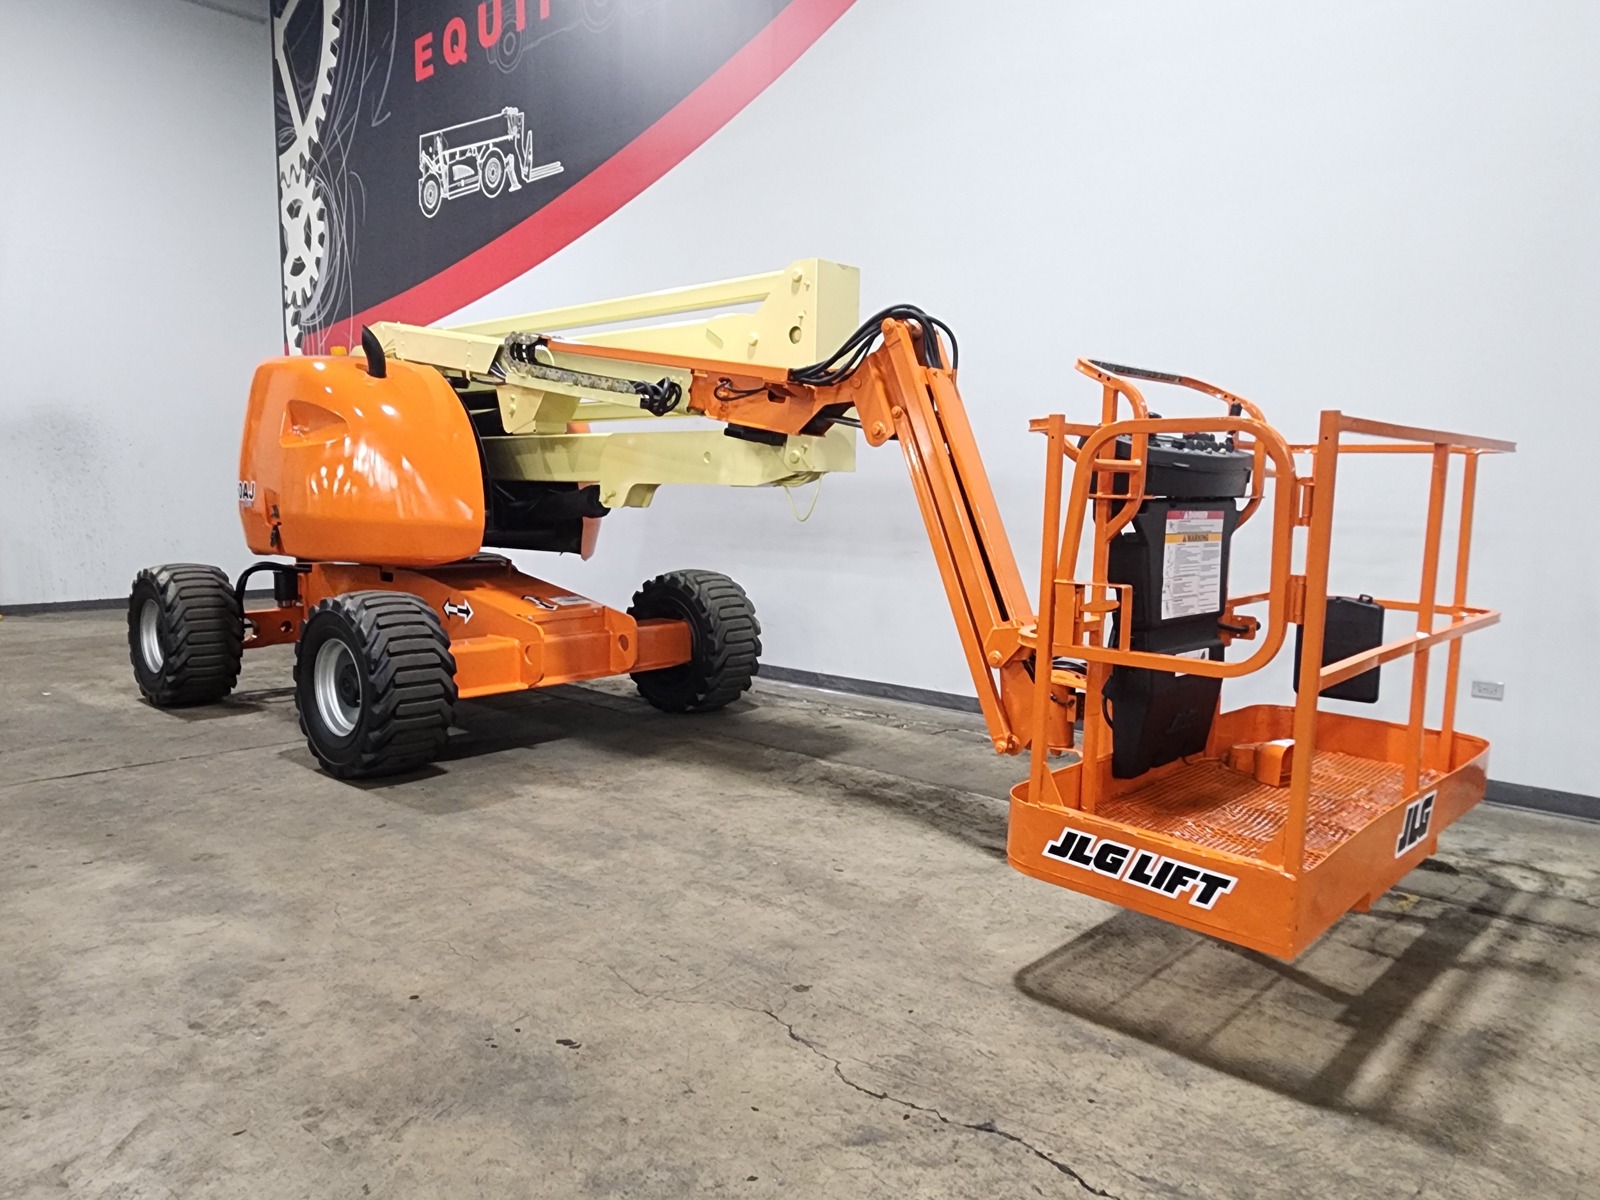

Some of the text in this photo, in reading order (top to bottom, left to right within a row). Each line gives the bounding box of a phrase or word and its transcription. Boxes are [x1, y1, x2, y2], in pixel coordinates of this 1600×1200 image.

[1398, 793, 1436, 854] JLG
[1047, 830, 1232, 905] JLG LIFT
